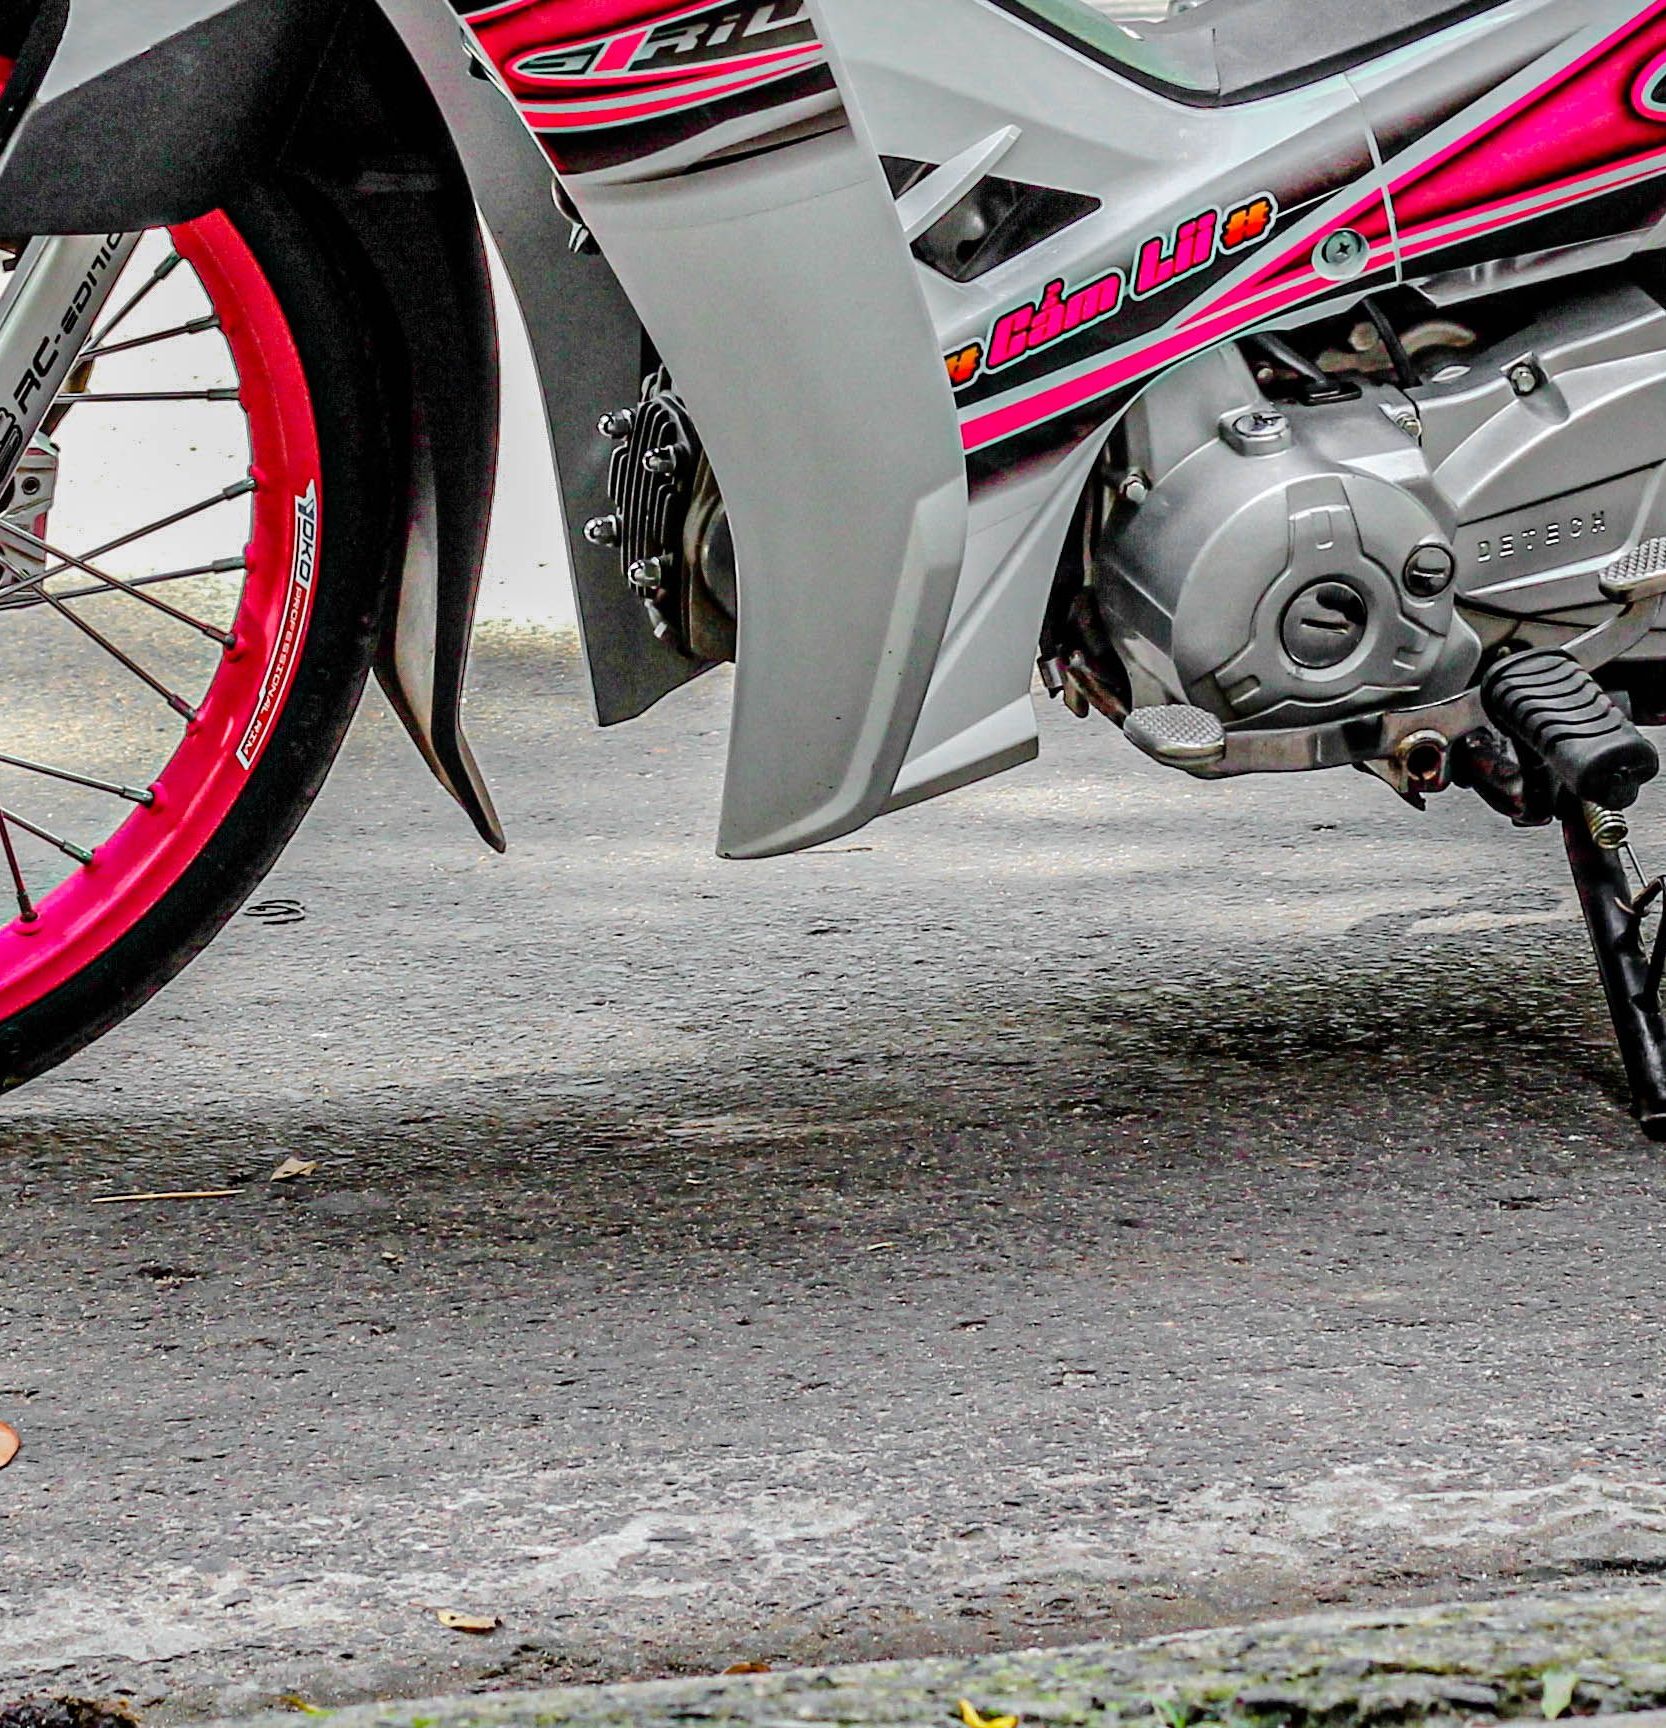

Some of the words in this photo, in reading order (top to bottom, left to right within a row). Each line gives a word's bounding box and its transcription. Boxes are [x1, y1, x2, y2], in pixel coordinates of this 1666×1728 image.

[297, 498, 315, 583] YOKO
[261, 586, 302, 714] PROFESSIONAL
[243, 719, 263, 757] RIM
